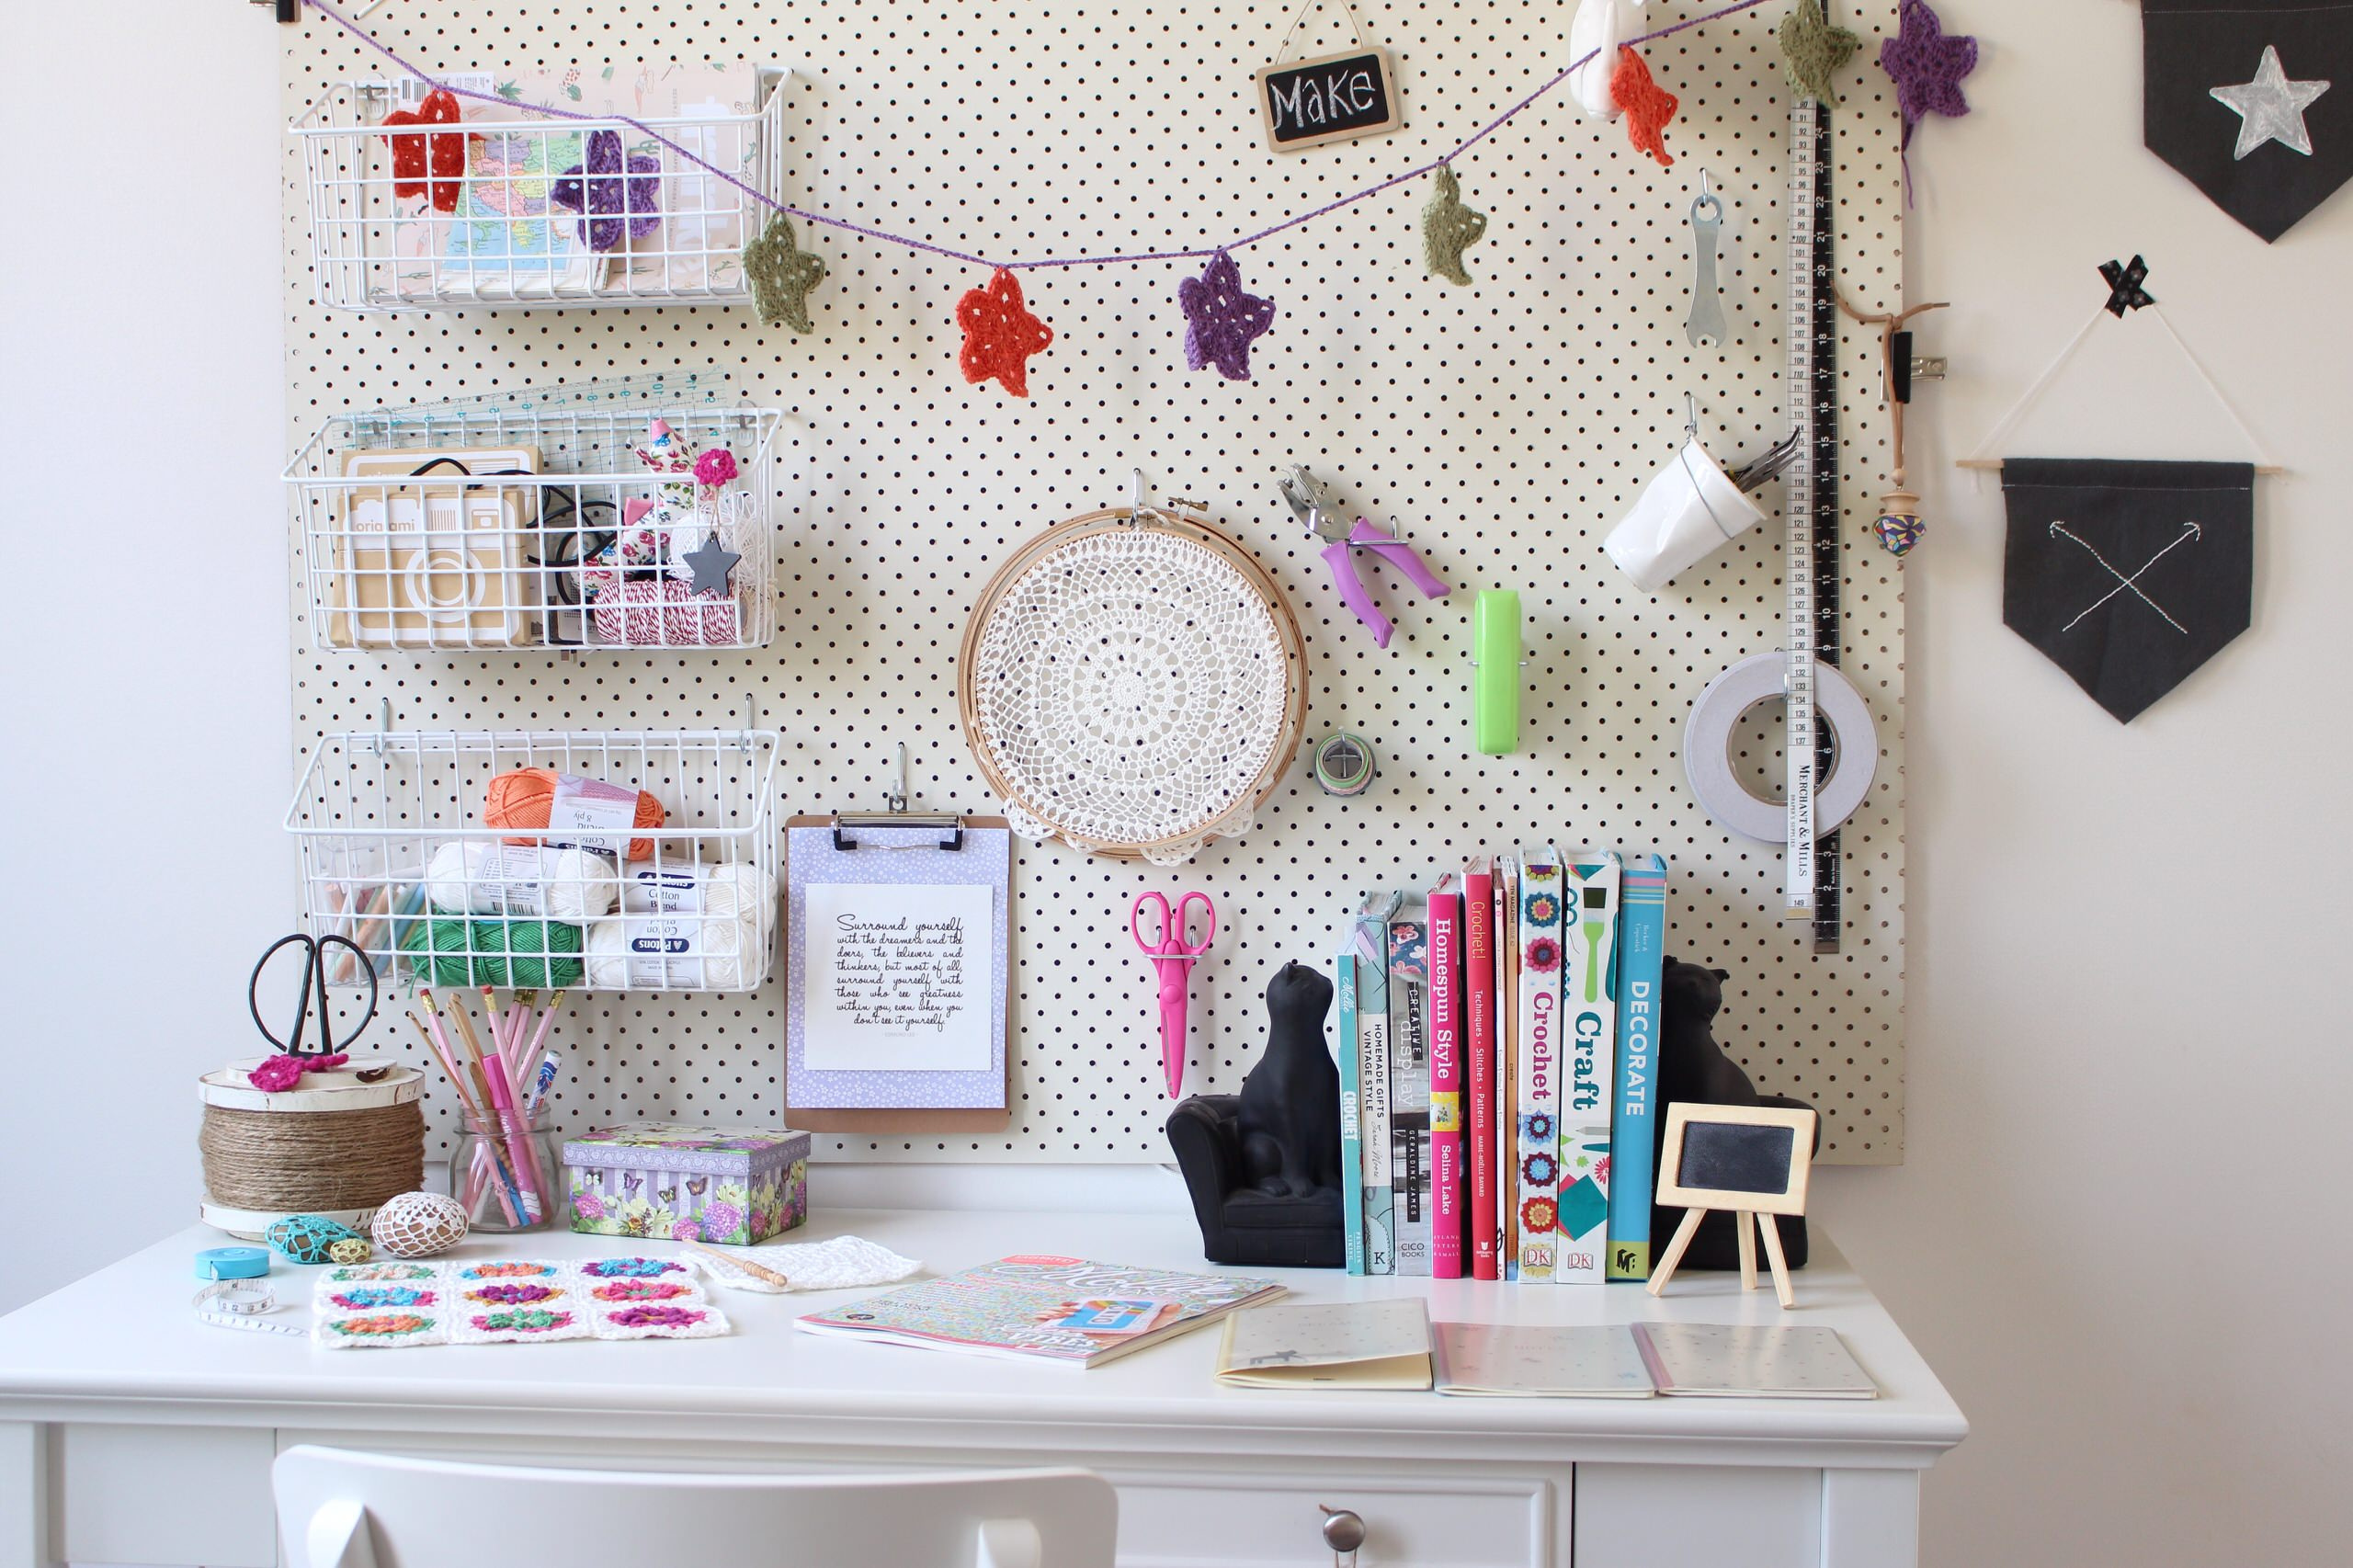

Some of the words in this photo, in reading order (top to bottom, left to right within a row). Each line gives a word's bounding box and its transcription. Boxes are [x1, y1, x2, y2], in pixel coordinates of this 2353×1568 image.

[1799, 127, 1807, 135] 92
[1816, 128, 1824, 140] 24
[1798, 153, 1806, 162] 94
[1816, 162, 1824, 173] 23
[1816, 197, 1824, 208] 22
[1797, 208, 1806, 216] 98
[1797, 222, 1805, 230] 99
[1817, 232, 1825, 242] 21
[1795, 262, 1806, 270] 102
[1818, 265, 1825, 277] 20
[1794, 289, 1805, 297] 104
[1818, 299, 1826, 311] 19
[1794, 329, 1805, 337] 107
[1819, 333, 1827, 345] 18
[1794, 343, 1805, 351] 108
[1793, 357, 1804, 365] 109
[1793, 370, 1804, 379] 110
[1820, 368, 1828, 379] 17
[1793, 384, 1804, 392] 111
[1820, 402, 1829, 414] 16
[1821, 436, 1829, 448] 15
[1793, 465, 1804, 473] 117
[1821, 471, 1829, 482] 14
[1793, 479, 1804, 487] 118
[1794, 506, 1805, 514] 120
[1822, 506, 1830, 517] 13
[357, 519, 415, 531] origami
[1794, 519, 1805, 528] 121
[1794, 546, 1805, 554] 123
[1822, 540, 1830, 551] 12
[1794, 560, 1805, 568] 124
[1822, 574, 1831, 585] 11
[1794, 600, 1805, 608] 127
[1794, 614, 1805, 622] 128
[1823, 608, 1831, 619] 10
[1794, 628, 1805, 636] 129
[1794, 696, 1805, 704] 134
[1794, 710, 1805, 718] 135
[1795, 723, 1806, 732] 136
[1799, 765, 1810, 824] MERCHANT
[574, 811, 585, 821] ply
[1799, 827, 1807, 838] &
[1799, 842, 1809, 877] MILLS
[836, 913, 907, 931] Surround
[915, 916, 963, 938] yourself
[1472, 902, 1485, 960] Crochet!
[639, 939, 673, 950] Ptons
[837, 934, 859, 944] with
[879, 934, 923, 944] dreamers
[926, 934, 947, 944] and
[837, 946, 864, 958] doers,
[896, 946, 934, 958] believers
[943, 946, 963, 958] and
[835, 959, 881, 971] thinkers,
[885, 960, 902, 971] but
[905, 960, 928, 971] most
[932, 960, 942, 978] of
[947, 960, 962, 972] all,
[1433, 919, 1450, 1024] Homespun
[837, 972, 884, 984] surround
[892, 972, 931, 991] yourself
[939, 975, 963, 984] with
[835, 987, 860, 997] those
[870, 988, 890, 997] who
[919, 988, 963, 1005] greatness
[1342, 976, 1355, 1013] Mollie
[836, 999, 870, 1011] within
[874, 1004, 891, 1017] you,
[918, 1000, 942, 1011] when
[947, 1004, 962, 1017] you
[1474, 990, 1483, 1037] Techniques
[881, 1016, 892, 1025] see
[895, 1014, 904, 1025] it
[1410, 989, 1422, 1053] CREATIVE
[1532, 992, 1553, 1100] Crochet
[1625, 982, 1650, 1116] DECORATE
[1364, 1030, 1372, 1075] VINTAGE
[1374, 1024, 1383, 1085] HOMEMADE
[1434, 1029, 1452, 1079] Style
[1397, 1020, 1417, 1106] display
[1573, 1011, 1601, 1110] Craft
[1365, 1079, 1373, 1112] STYLE
[1343, 1090, 1358, 1141] CROCHET
[1476, 1093, 1485, 1129] Patterns
[1371, 1151, 1382, 1178] Moore
[1441, 1145, 1450, 1182] Selina
[1441, 1185, 1451, 1215] Lake
[1401, 1243, 1425, 1251] CICO
[1374, 1252, 1386, 1264] K
[1526, 1249, 1549, 1264] DK
[1570, 1254, 1591, 1267] DK
